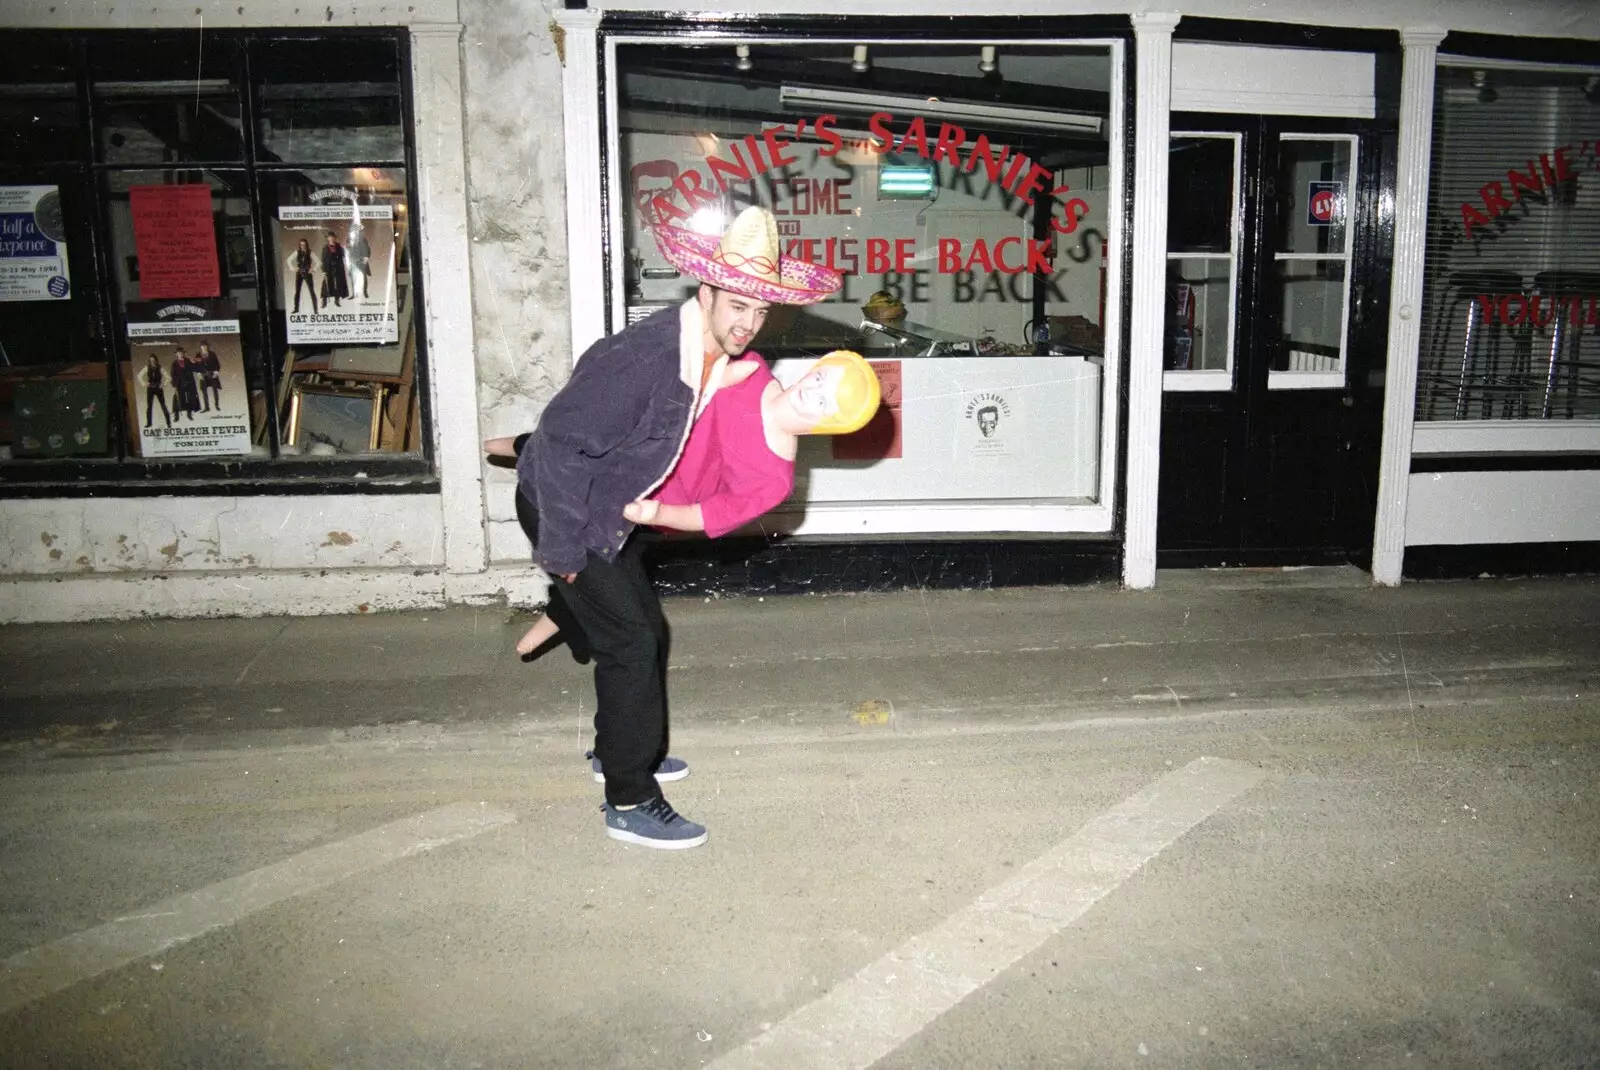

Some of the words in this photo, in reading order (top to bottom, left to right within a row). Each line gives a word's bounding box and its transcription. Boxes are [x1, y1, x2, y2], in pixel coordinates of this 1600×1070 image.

[652, 113, 843, 227] ARNIE'S
[867, 110, 1090, 235] SARNIE'S
[1460, 139, 1600, 241] ARNIE'
[866, 237, 917, 274] BE
[938, 236, 1054, 275] BACK
[290, 315, 308, 323] CAT
[310, 314, 356, 323] SCRATCH
[359, 313, 395, 322] FEVER
[143, 428, 161, 437] CAT
[164, 426, 210, 437] SCRATCH
[212, 425, 247, 434] FEVER
[173, 440, 220, 448] TONIGHT
